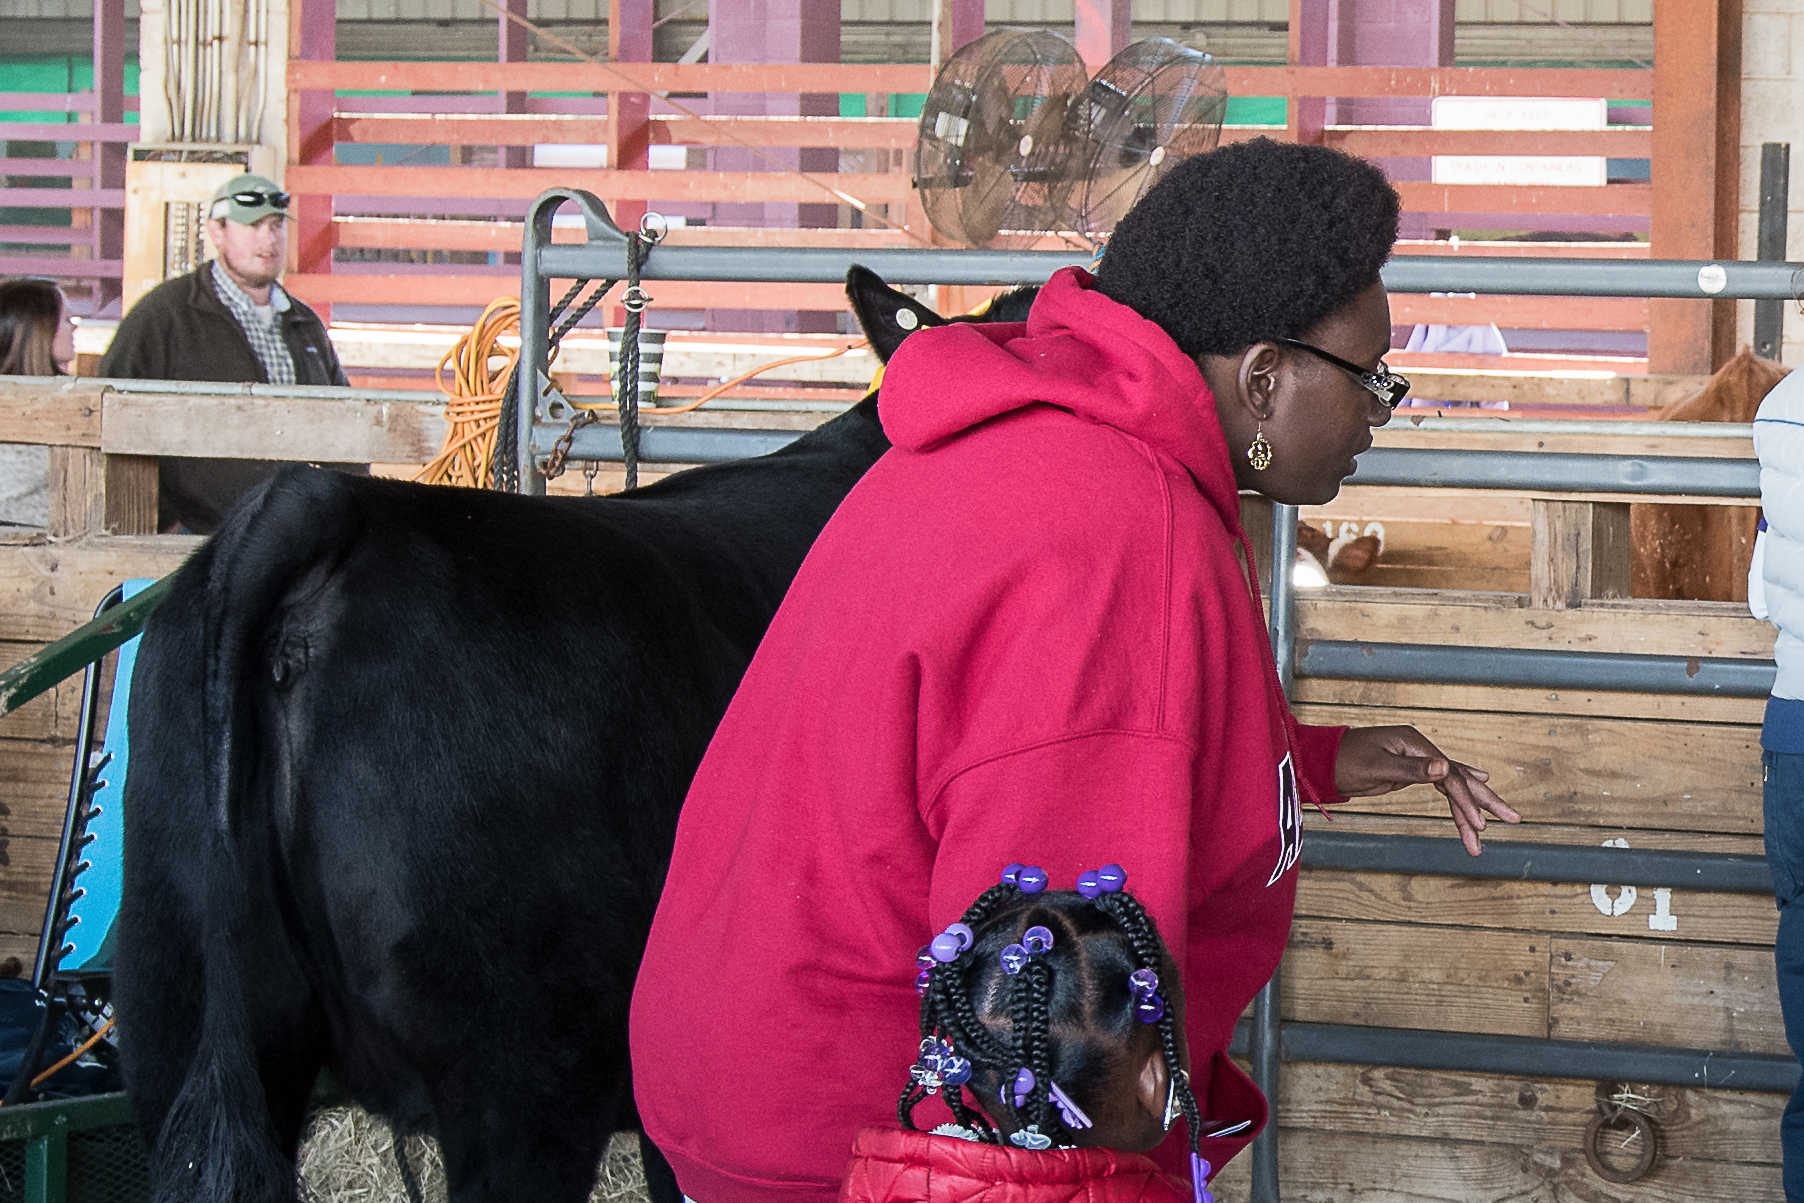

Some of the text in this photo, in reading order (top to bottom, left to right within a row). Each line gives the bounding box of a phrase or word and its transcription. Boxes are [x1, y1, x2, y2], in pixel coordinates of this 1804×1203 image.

[1485, 109, 1551, 120] HELP KEEP
[1451, 161, 1582, 172] TRASH IN CONTAINERS
